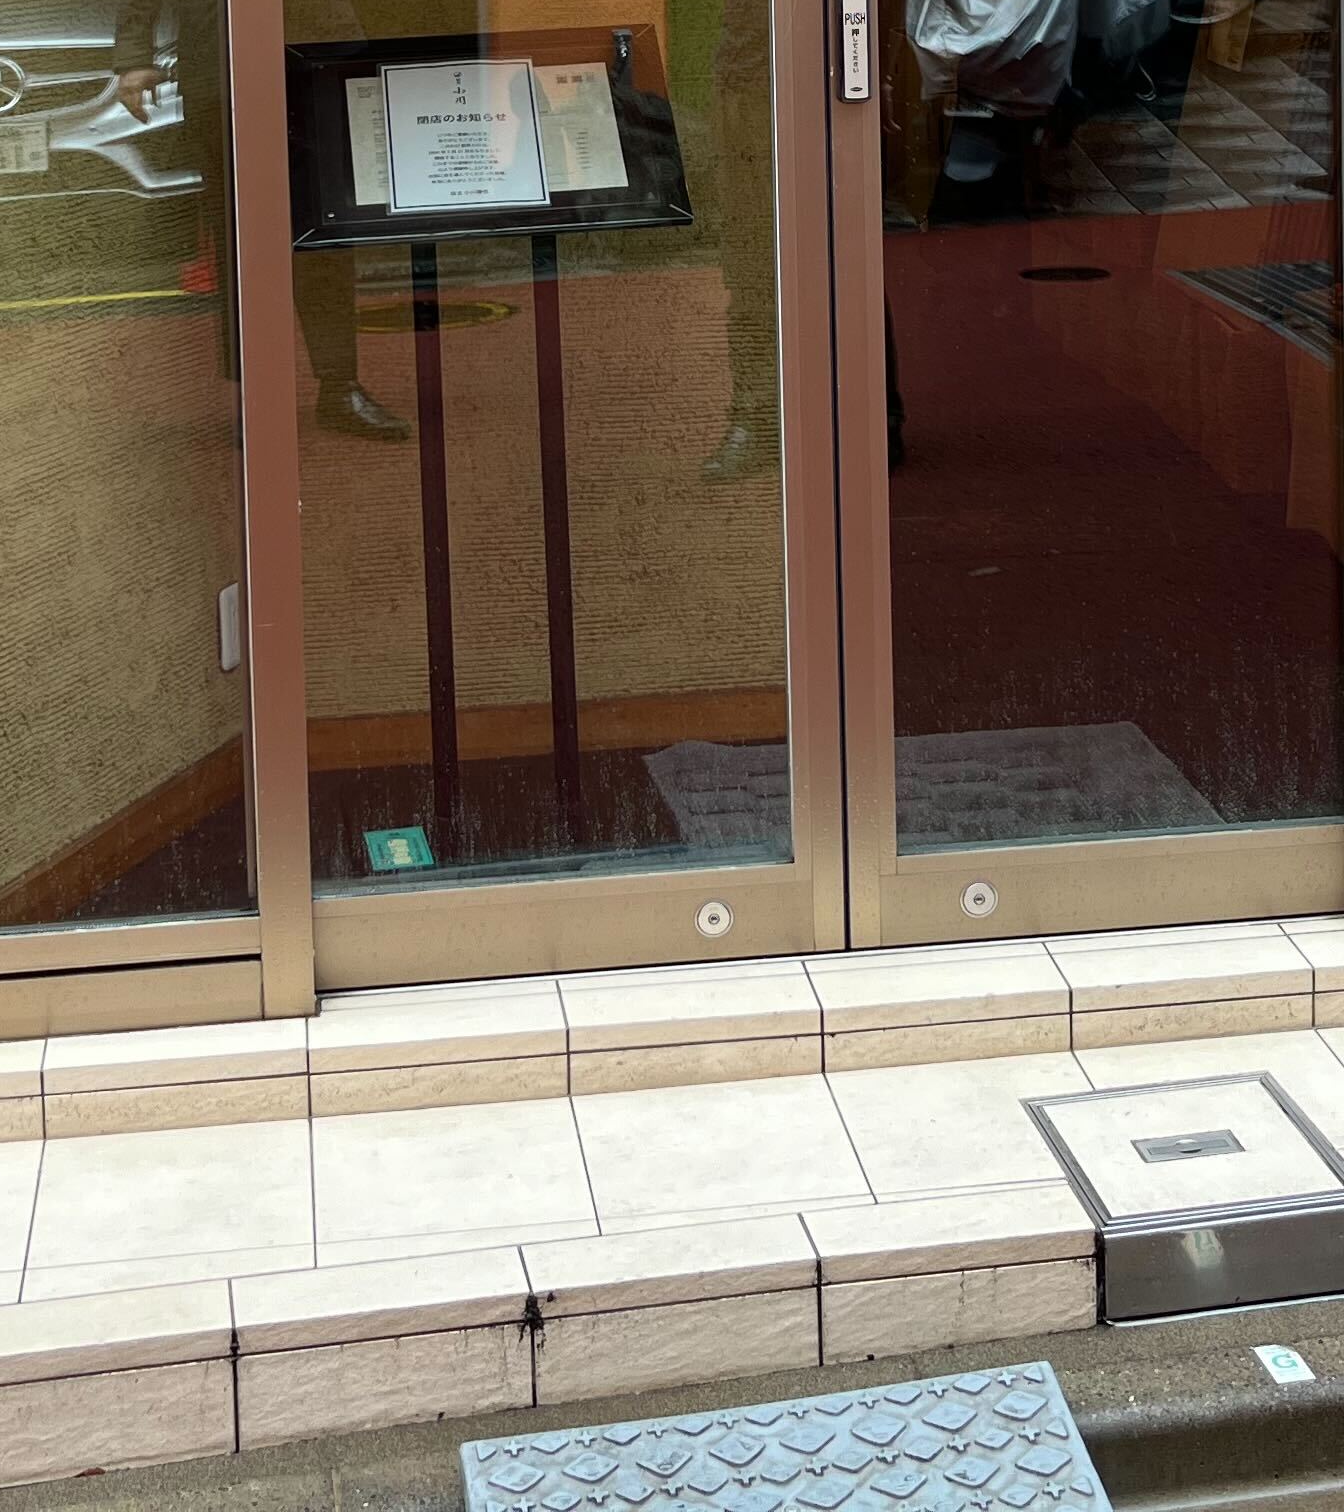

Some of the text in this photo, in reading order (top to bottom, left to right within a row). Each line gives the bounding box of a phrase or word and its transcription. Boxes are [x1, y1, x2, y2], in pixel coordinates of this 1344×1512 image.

[844, 12, 866, 26] PUSH
[851, 28, 860, 74] 押してください
[452, 86, 467, 105] 小川
[416, 113, 507, 126] 閉店のお知らせ
[1272, 1352, 1298, 1368] G
